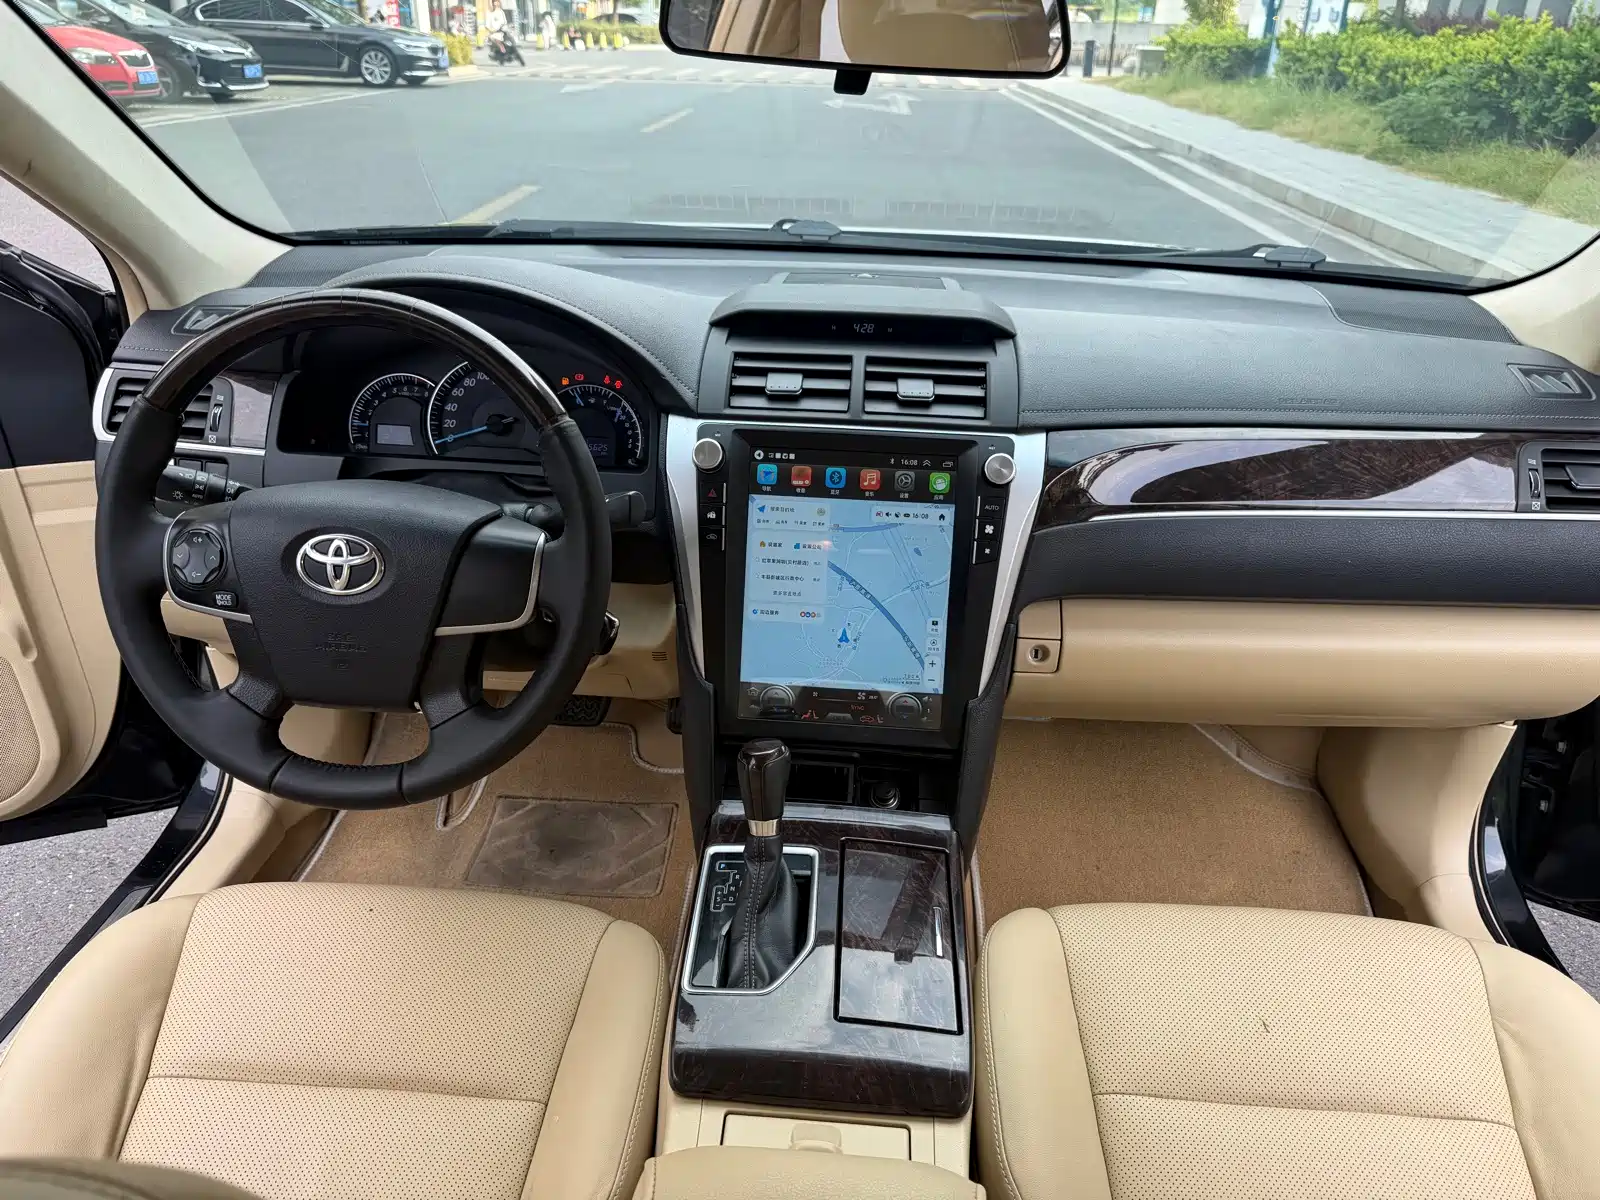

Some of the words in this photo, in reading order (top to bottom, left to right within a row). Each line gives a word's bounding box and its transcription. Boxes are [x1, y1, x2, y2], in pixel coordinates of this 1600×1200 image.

[463, 378, 476, 387] 80
[451, 387, 465, 397] 60
[444, 402, 458, 412] 40
[442, 419, 457, 428] 20
[984, 504, 1000, 512] AUTO
[912, 512, 929, 520] 16:08
